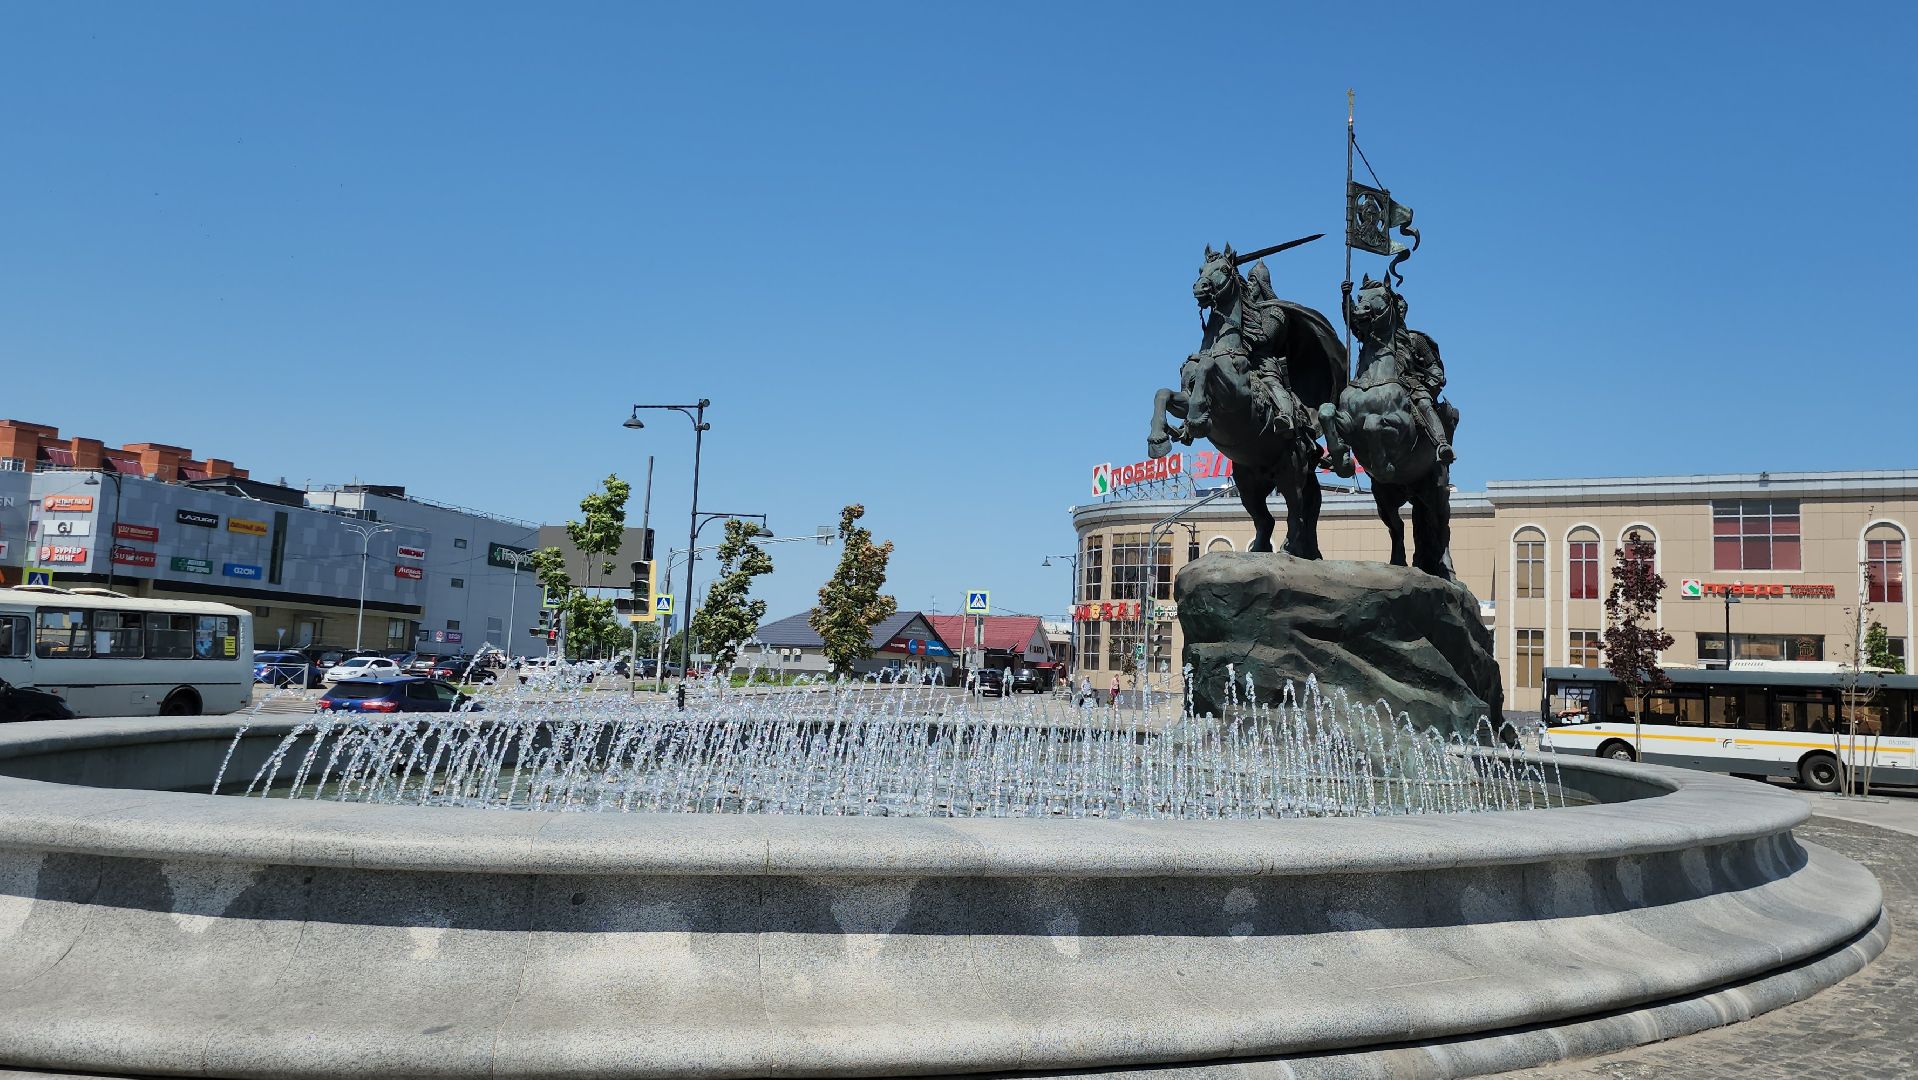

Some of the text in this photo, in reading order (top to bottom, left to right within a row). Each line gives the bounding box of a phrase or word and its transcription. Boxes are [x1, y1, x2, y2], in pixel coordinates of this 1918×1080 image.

[54, 546, 82, 554] БУРГЕР
[53, 554, 75, 562] КИНГ
[233, 567, 256, 576] OZON
